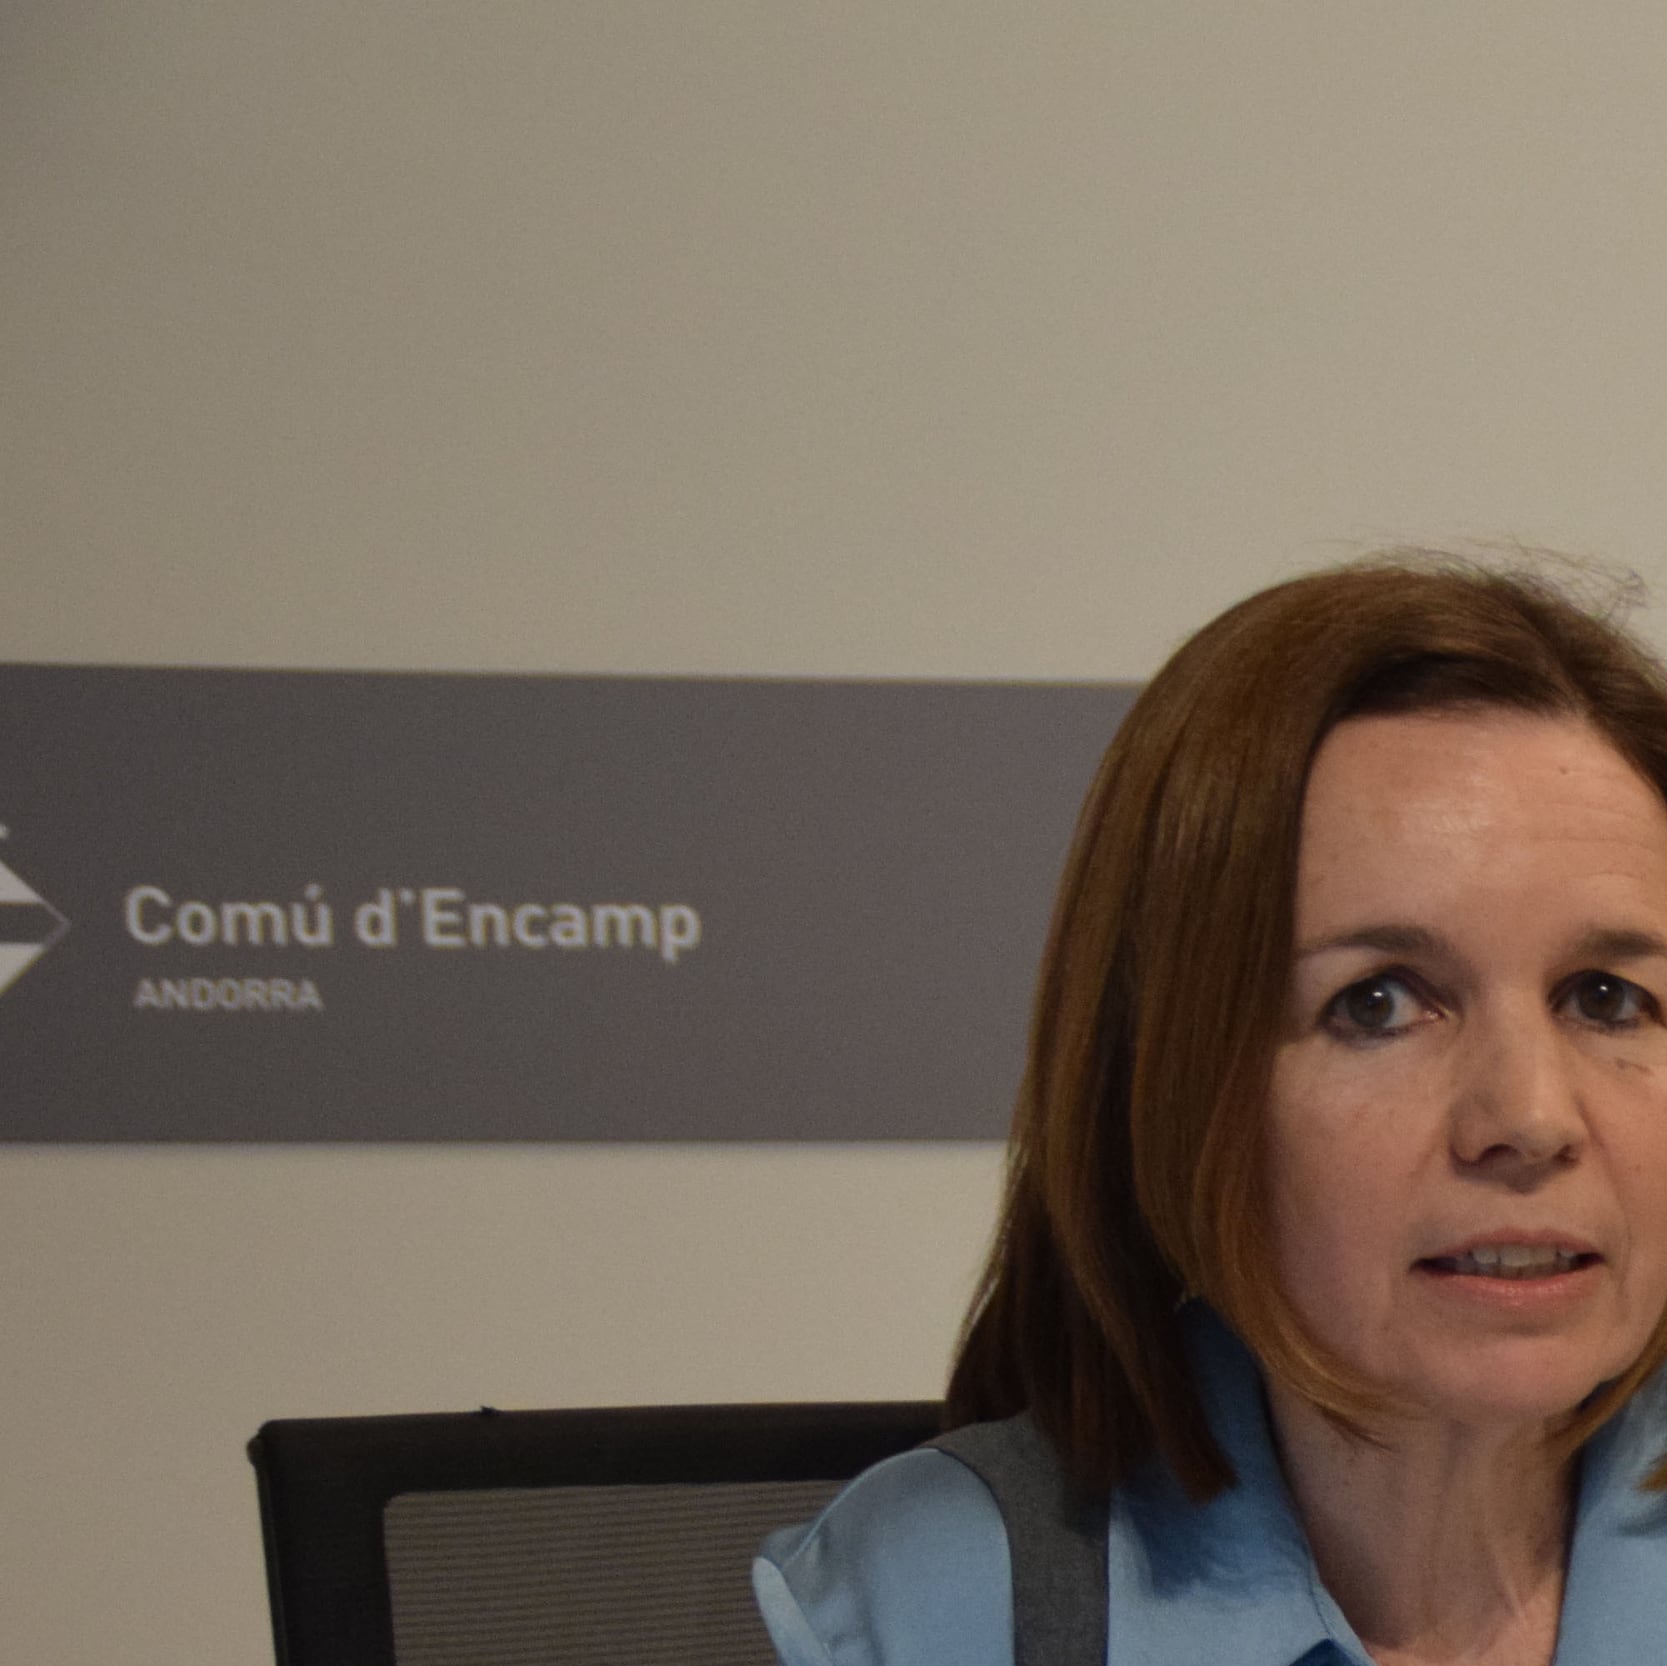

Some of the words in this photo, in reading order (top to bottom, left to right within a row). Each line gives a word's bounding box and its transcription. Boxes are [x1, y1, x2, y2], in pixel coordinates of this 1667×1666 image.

[124, 883, 333, 948] Comú
[355, 886, 700, 964] d'Encamp
[134, 978, 324, 1012] ANDORRA
